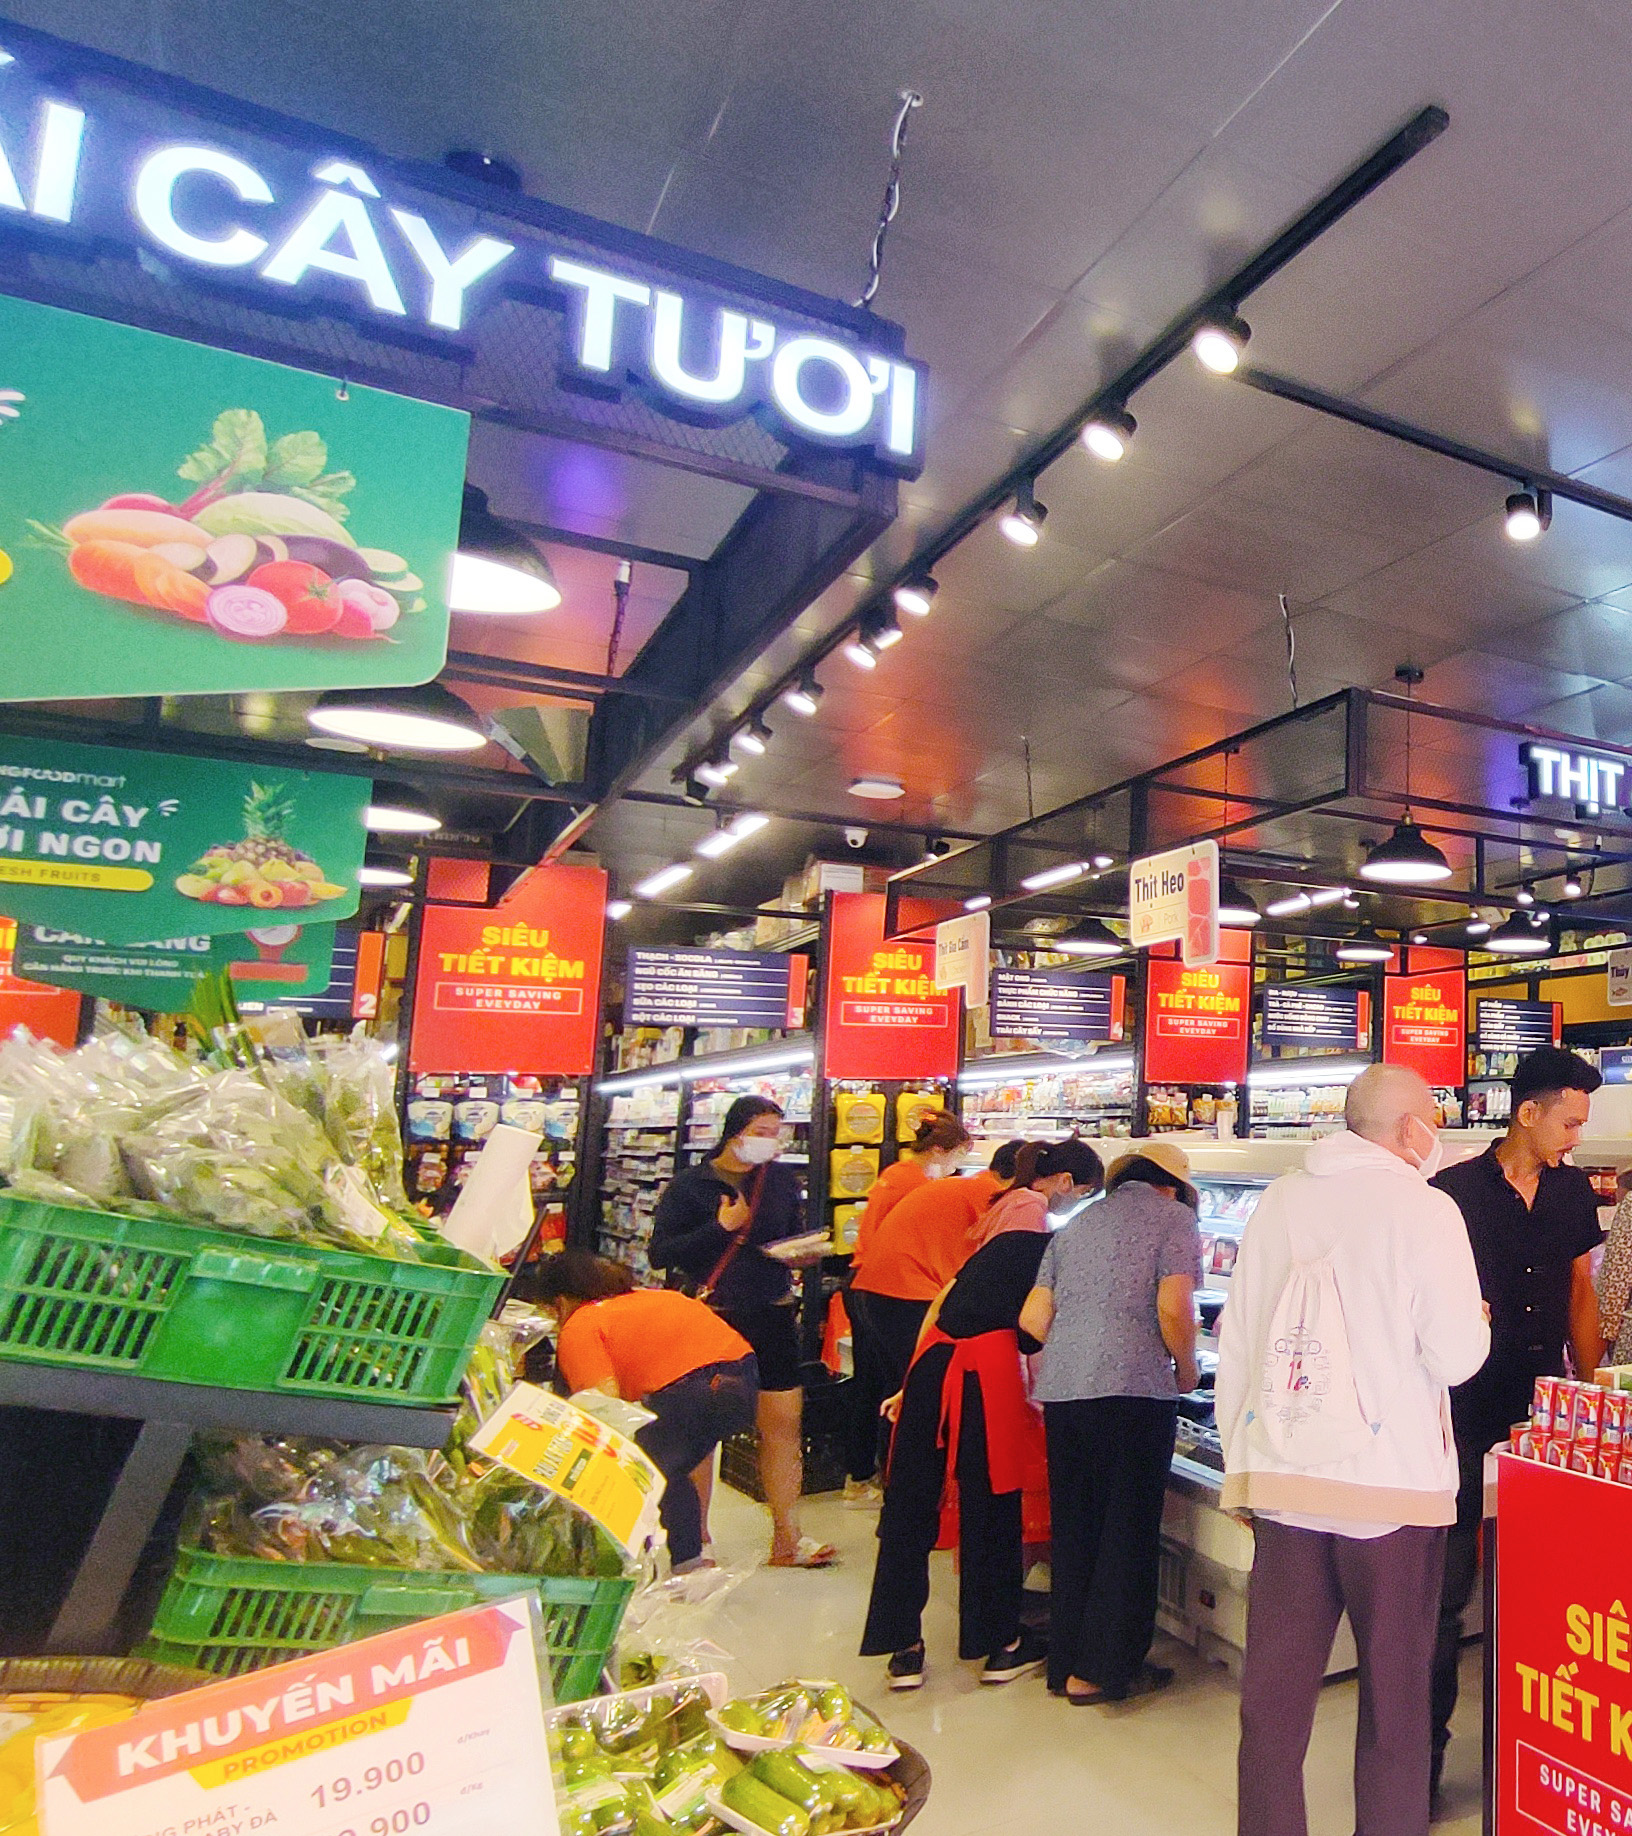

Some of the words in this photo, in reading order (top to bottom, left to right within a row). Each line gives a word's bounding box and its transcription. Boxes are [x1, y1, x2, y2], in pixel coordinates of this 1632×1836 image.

[133, 145, 515, 331] CÂY
[550, 256, 915, 456] TƯƠI
[1530, 747, 1625, 813] THỊT
[61, 794, 149, 828] CÂY
[38, 831, 162, 863] NGON
[39, 868, 101, 882] FRUITS
[1135, 874, 1158, 908] Thịt
[1162, 870, 1185, 896] Heo
[481, 921, 549, 948] SIÊU
[438, 947, 505, 974] TIẾT
[511, 952, 584, 983] KIỆM
[873, 947, 922, 970] SIÊU
[842, 970, 891, 994] TIẾT
[1181, 969, 1220, 989] SIÊU
[1410, 983, 1441, 1001] SIÊU
[359, 994, 376, 1015] 2
[455, 987, 503, 997] SUPER
[508, 989, 562, 1000] SAVING
[1158, 988, 1196, 1009] TIẾT
[1198, 991, 1240, 1015] KIỆM
[791, 1007, 804, 1025] 3
[854, 1005, 891, 1014] SUPER
[894, 1006, 933, 1015] SAVING
[1168, 1018, 1196, 1026] SUPER
[1198, 1019, 1228, 1028] SAVING
[1393, 1002, 1423, 1021] TIẾT
[1425, 1004, 1458, 1025] KIỆM
[1113, 1022, 1123, 1037] 4
[117, 1673, 356, 1777] KHUYẾN
[371, 1633, 472, 1697] MÃI
[1515, 1661, 1600, 1743] TIẾT
[222, 1711, 388, 1780] PROMOTION
[310, 1751, 425, 1809] 19.900
[1539, 1763, 1602, 1814] SUPER
[183, 1804, 239, 1834] PHÁT
[250, 1808, 278, 1830] ĐÀ
